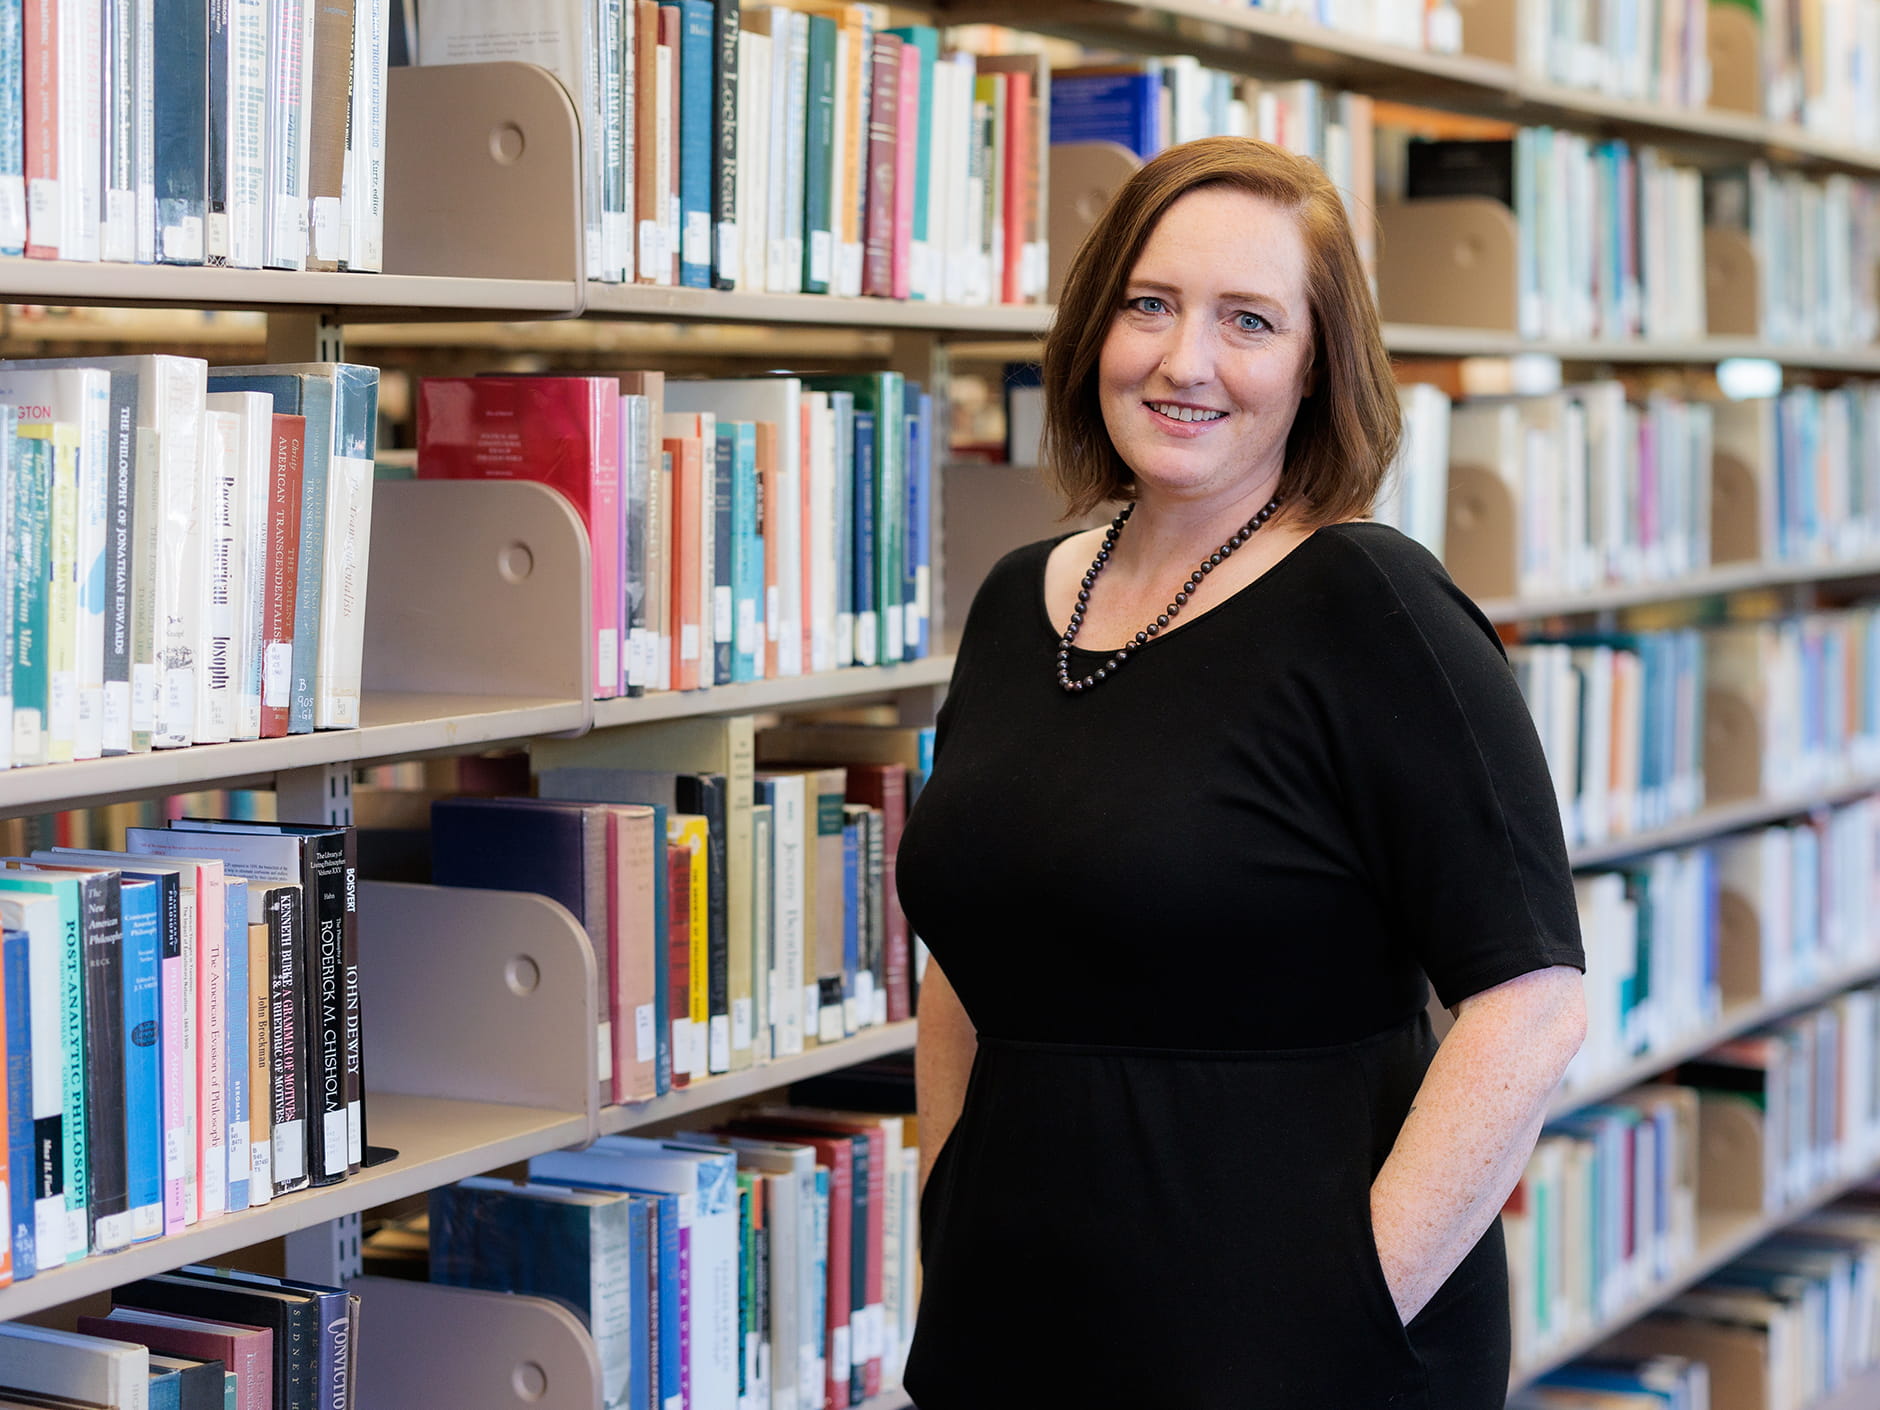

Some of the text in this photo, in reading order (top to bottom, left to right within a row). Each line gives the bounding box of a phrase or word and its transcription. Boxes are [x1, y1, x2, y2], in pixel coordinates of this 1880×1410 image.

[722, 10, 739, 63] The
[371, 43, 380, 86] THOUGHT
[371, 88, 380, 126] BEFORE
[721, 71, 738, 151] Locke
[371, 189, 380, 216] editor
[276, 436, 287, 503] AMERICAN
[114, 406, 130, 655] THE PHILOSOPHY OF JONATHAN EDWARDS
[285, 438, 300, 629] Christy THE ORIENT
[303, 478, 315, 609] TRANSCENDENTALISM
[313, 532, 321, 545] IN
[19, 629, 32, 667] Mind
[298, 678, 307, 692] B
[298, 695, 314, 708] 905
[88, 904, 105, 914] New
[346, 867, 356, 912] BOISVERT
[88, 918, 118, 930] American
[211, 944, 220, 968] The
[66, 920, 82, 1090] POST-ANALYTIC
[210, 972, 220, 1027] American
[280, 894, 296, 1121] KENNETH BURKE A GRAMMAR OF MOTIVES
[321, 919, 338, 1114] RODERICK M. CHISHOLM
[211, 1030, 220, 1073] Evasion
[258, 996, 267, 1068] John Brockman
[272, 981, 284, 1124] & A RHETORIC OF MOTIVES
[346, 1014, 359, 1075] DEWEY
[211, 1076, 221, 1088] of
[292, 1310, 301, 1384] SIDNEY
[327, 1317, 349, 1410] CONVICTIO
